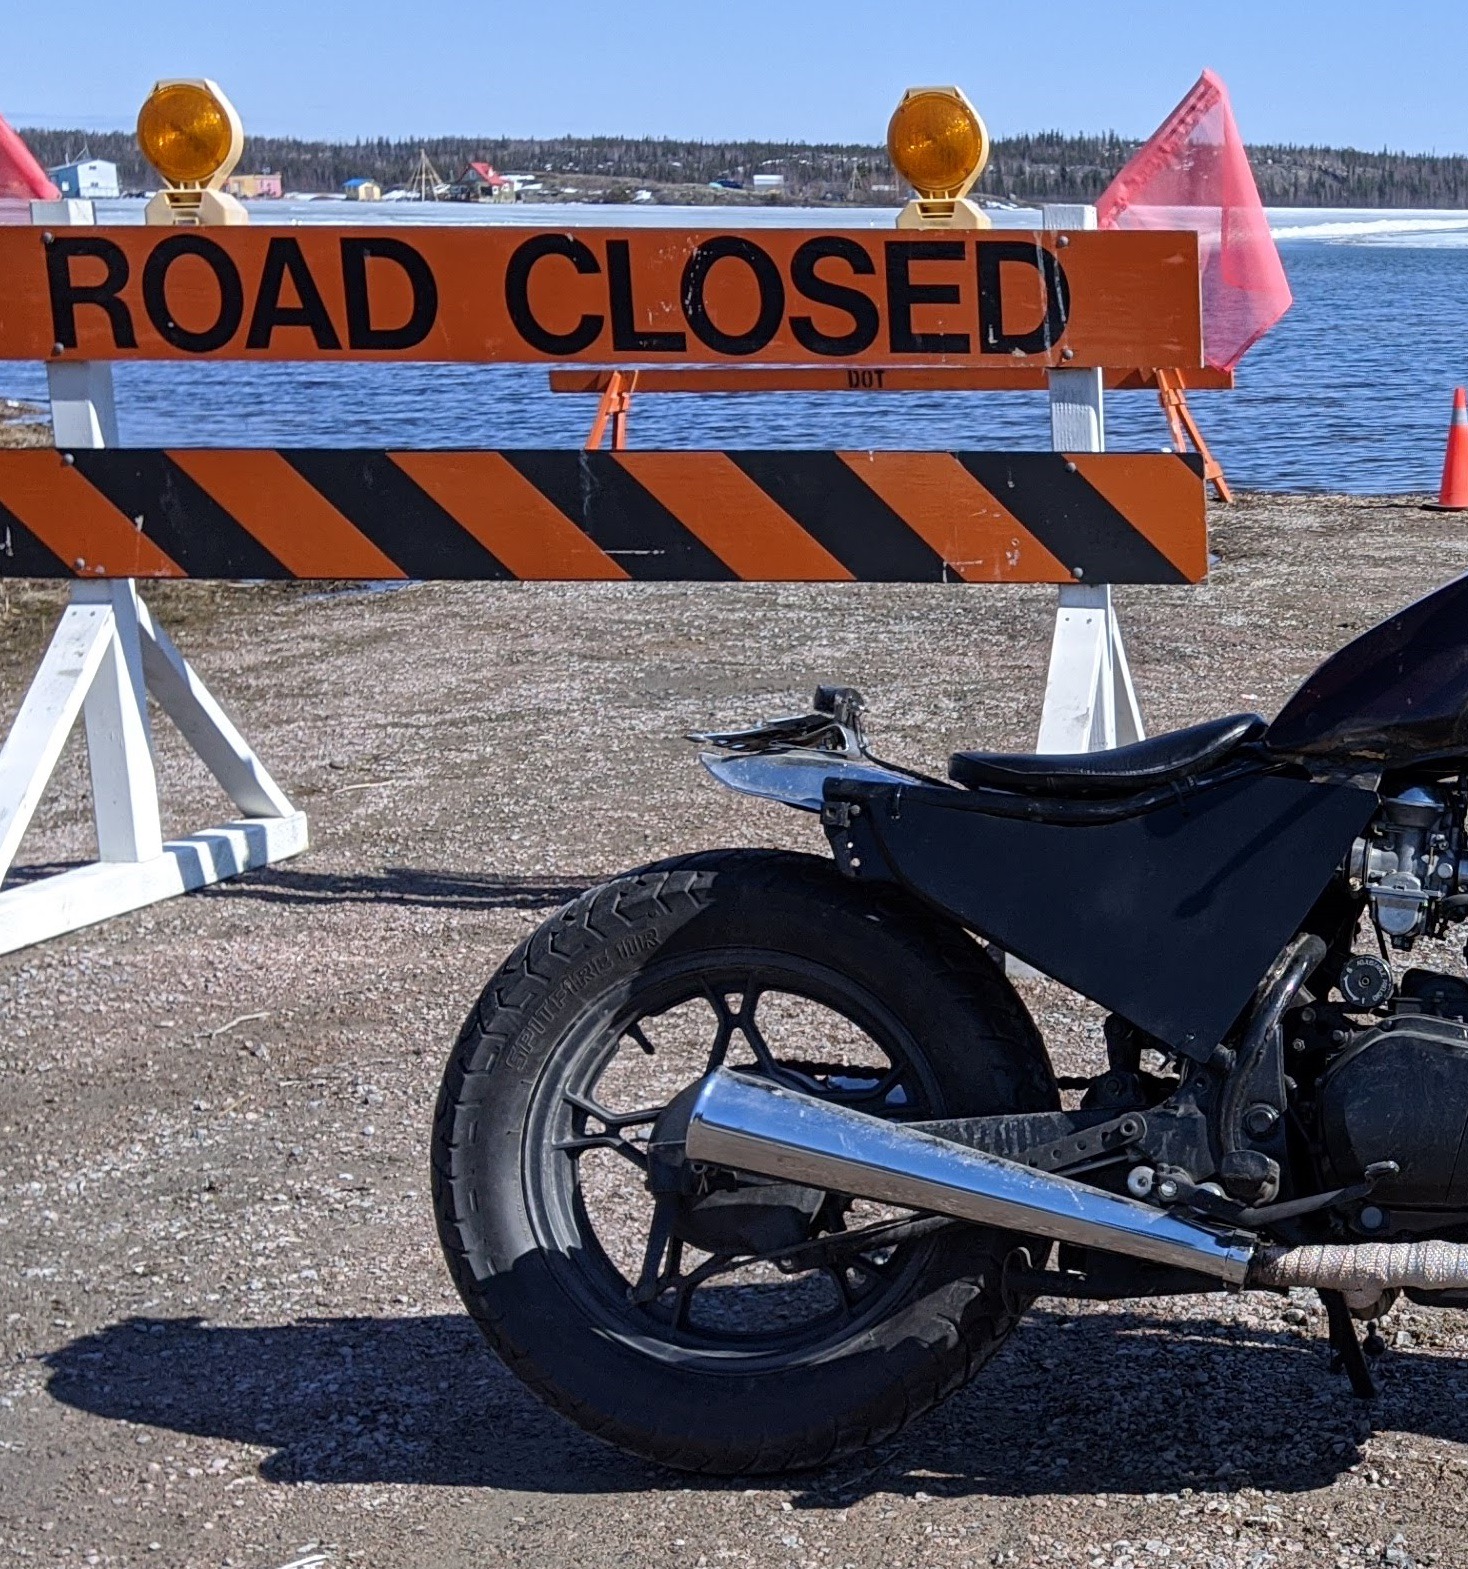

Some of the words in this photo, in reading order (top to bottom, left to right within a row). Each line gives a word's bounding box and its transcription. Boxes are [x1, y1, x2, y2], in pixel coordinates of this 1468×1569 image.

[47, 233, 438, 353] ROAD
[504, 233, 1071, 355] CLOSED
[847, 369, 885, 388] DOT
[505, 948, 614, 1071] SPITFIRE
